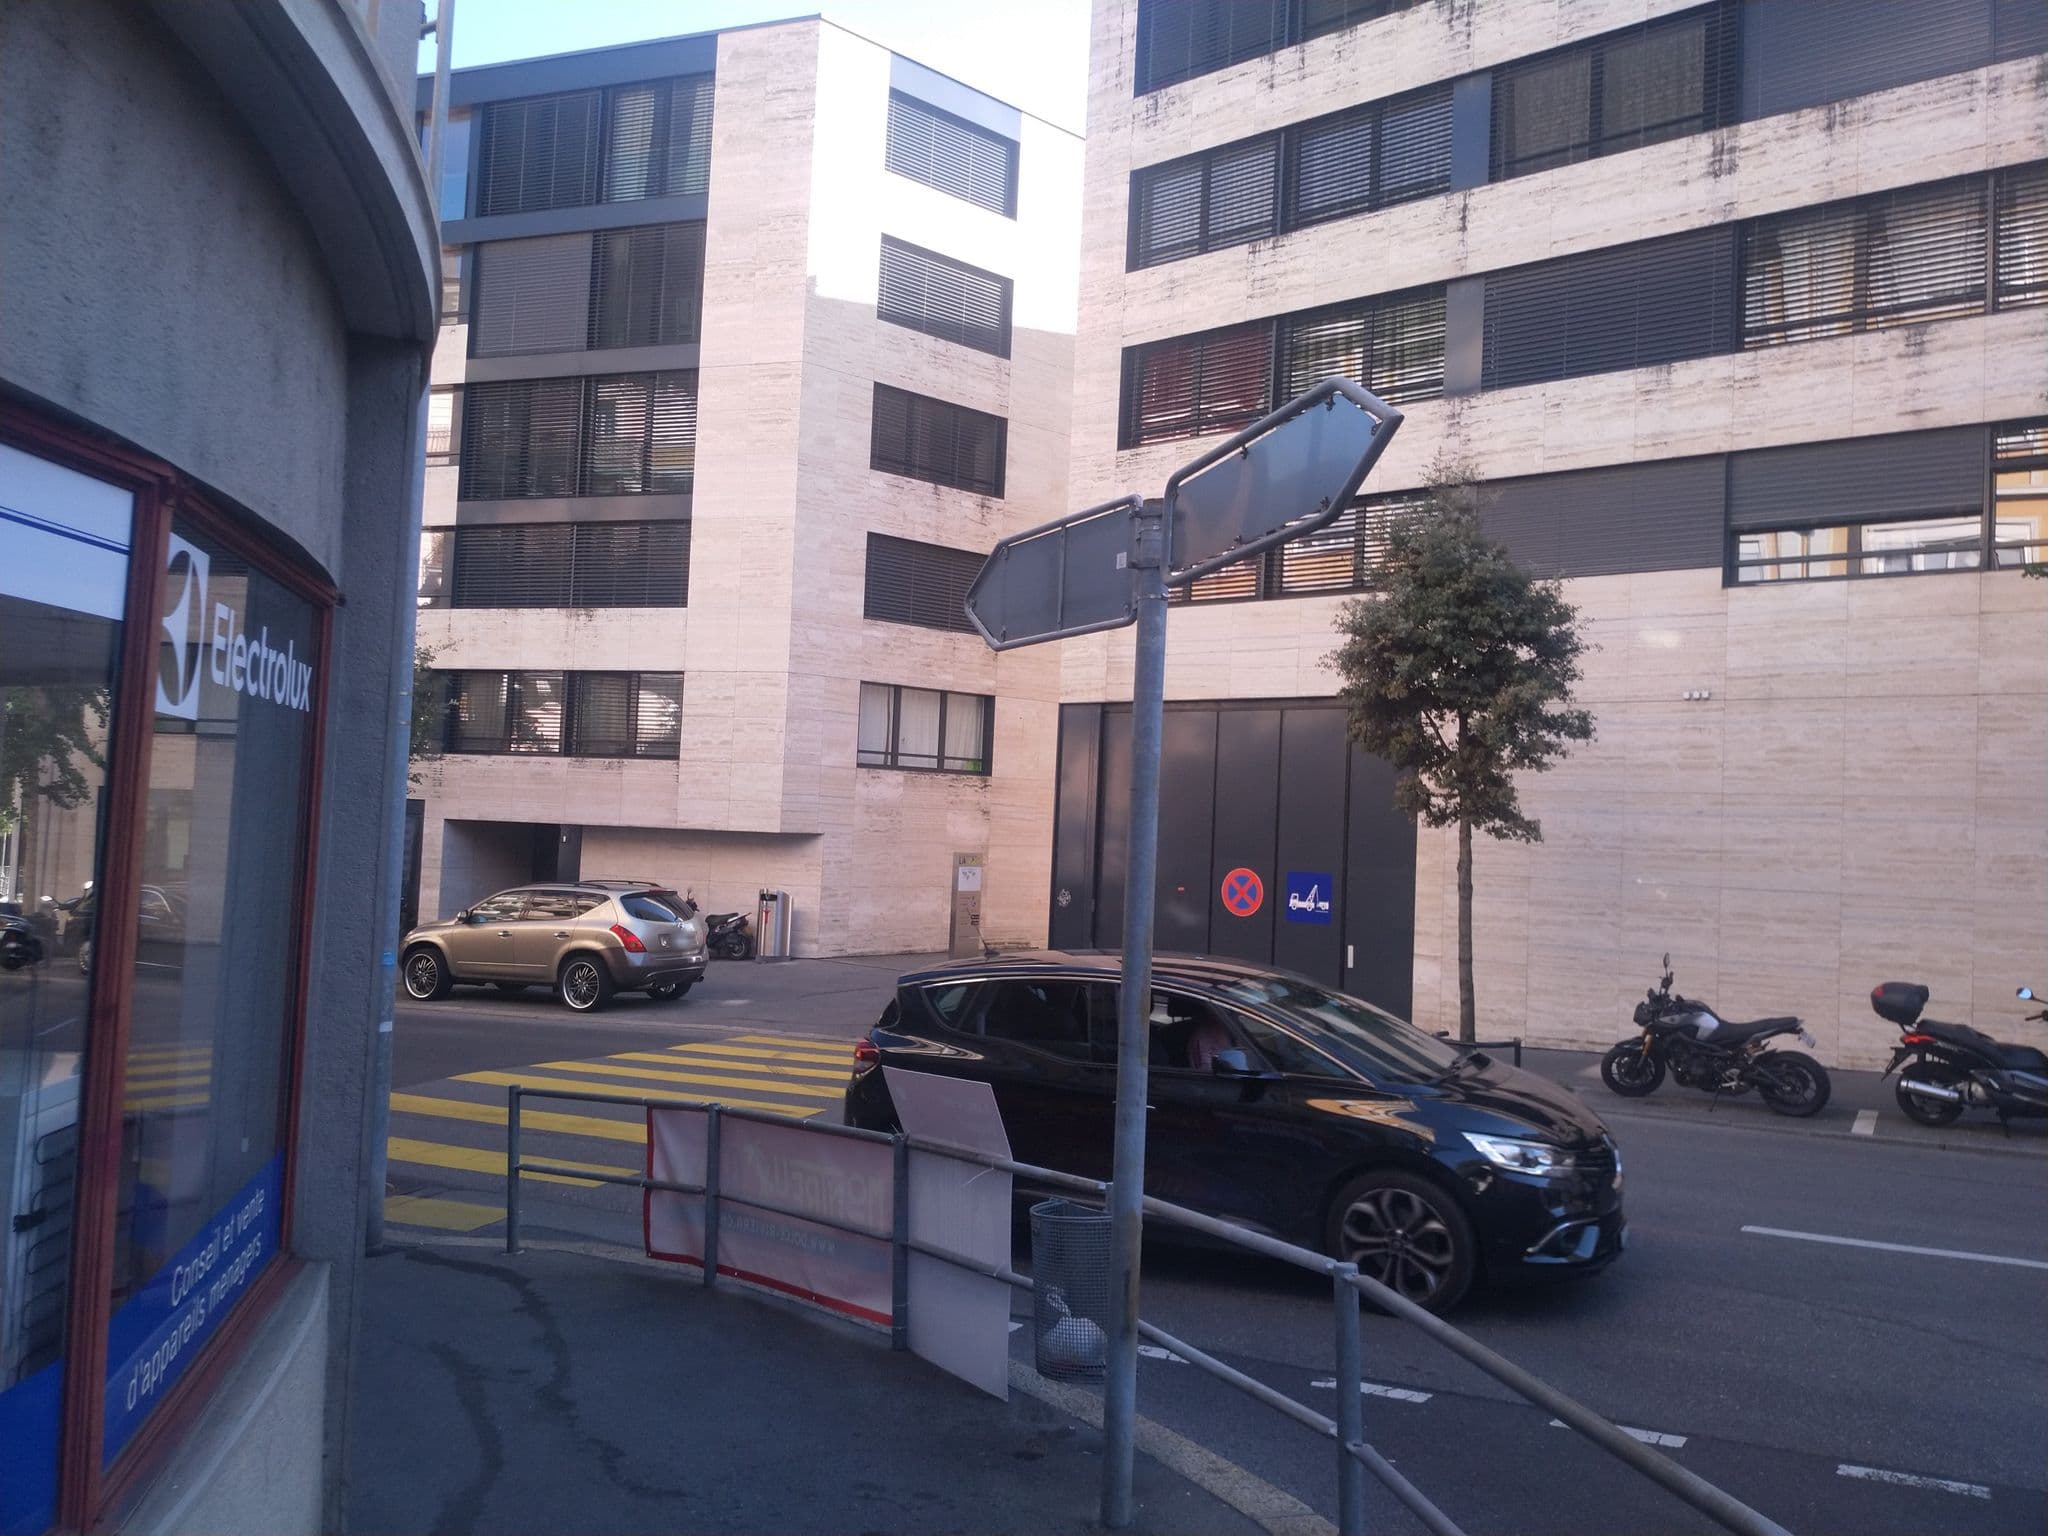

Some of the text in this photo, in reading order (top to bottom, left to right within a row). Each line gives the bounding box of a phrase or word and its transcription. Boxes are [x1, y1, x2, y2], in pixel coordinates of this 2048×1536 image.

[212, 603, 313, 712] Electrolux
[172, 1188, 265, 1307] Conseil et vente
[126, 1296, 206, 1412] d'appareils
